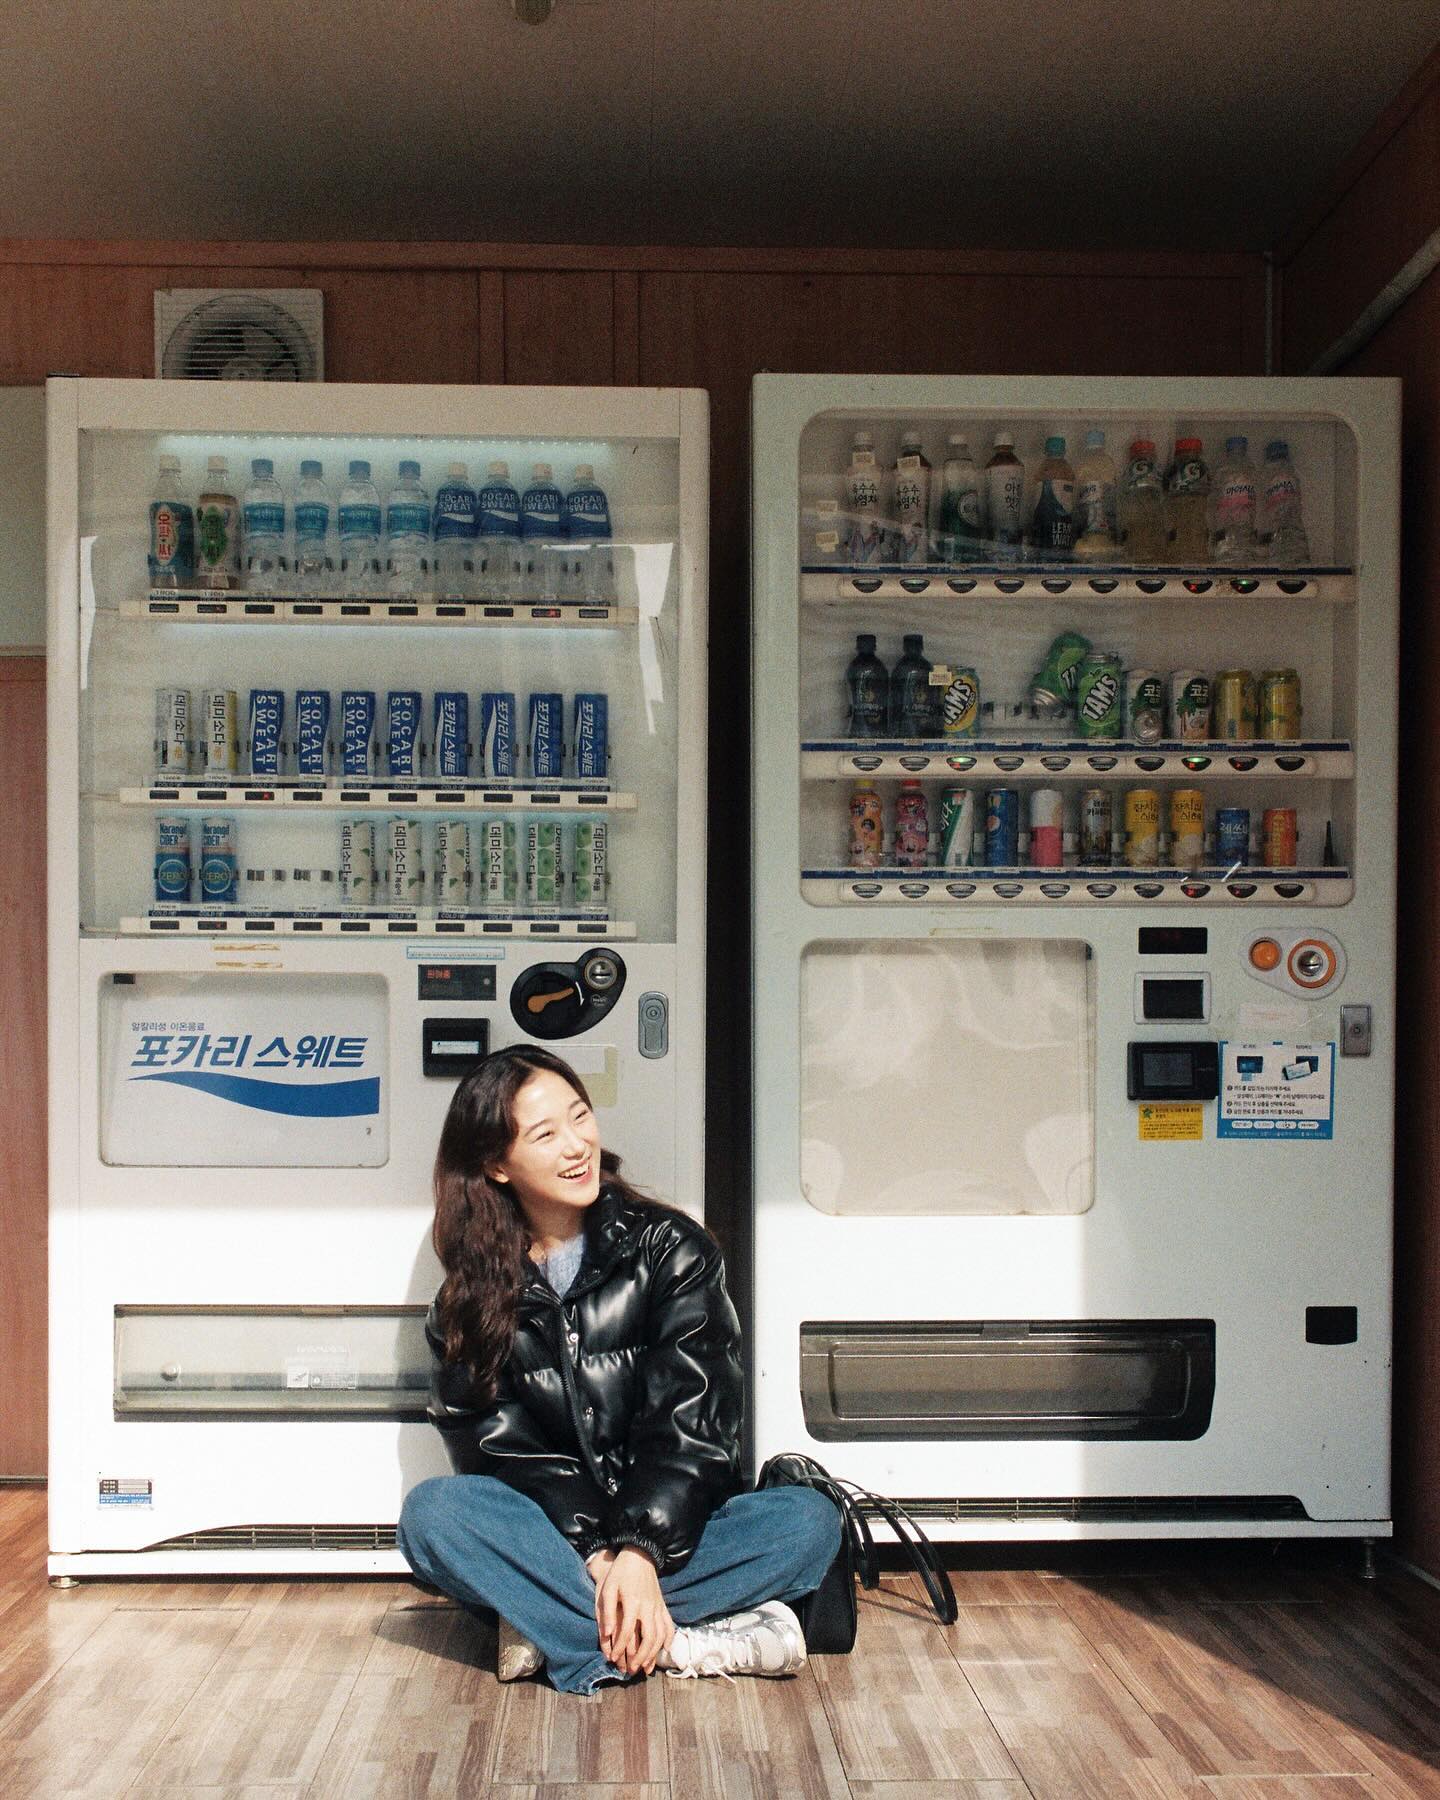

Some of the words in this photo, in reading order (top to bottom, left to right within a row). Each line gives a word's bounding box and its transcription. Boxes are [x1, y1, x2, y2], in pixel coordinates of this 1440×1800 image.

[173, 694, 187, 745] 데미소다
[212, 694, 226, 745] 데미소다
[1082, 673, 1118, 721] TAMS
[255, 694, 267, 765] SWEAT
[265, 694, 277, 773] POCARI
[300, 695, 312, 765] SWEAT
[311, 695, 322, 773] POCARI
[344, 696, 356, 766] SWEAT
[355, 696, 366, 775] POCARI
[390, 699, 401, 766] SWEAT
[400, 697, 412, 775] POCARI
[342, 825, 352, 876] 데미소다
[394, 825, 407, 876] 데미소다
[490, 826, 502, 876] 데미소다
[527, 827, 536, 875] 데미소다
[593, 827, 604, 877] 데미소다
[130, 1034, 252, 1068] 포카리
[252, 1035, 369, 1069] 스웨트
[131, 1022, 167, 1032] 알칼리성
[170, 1022, 205, 1032] 이온음료
